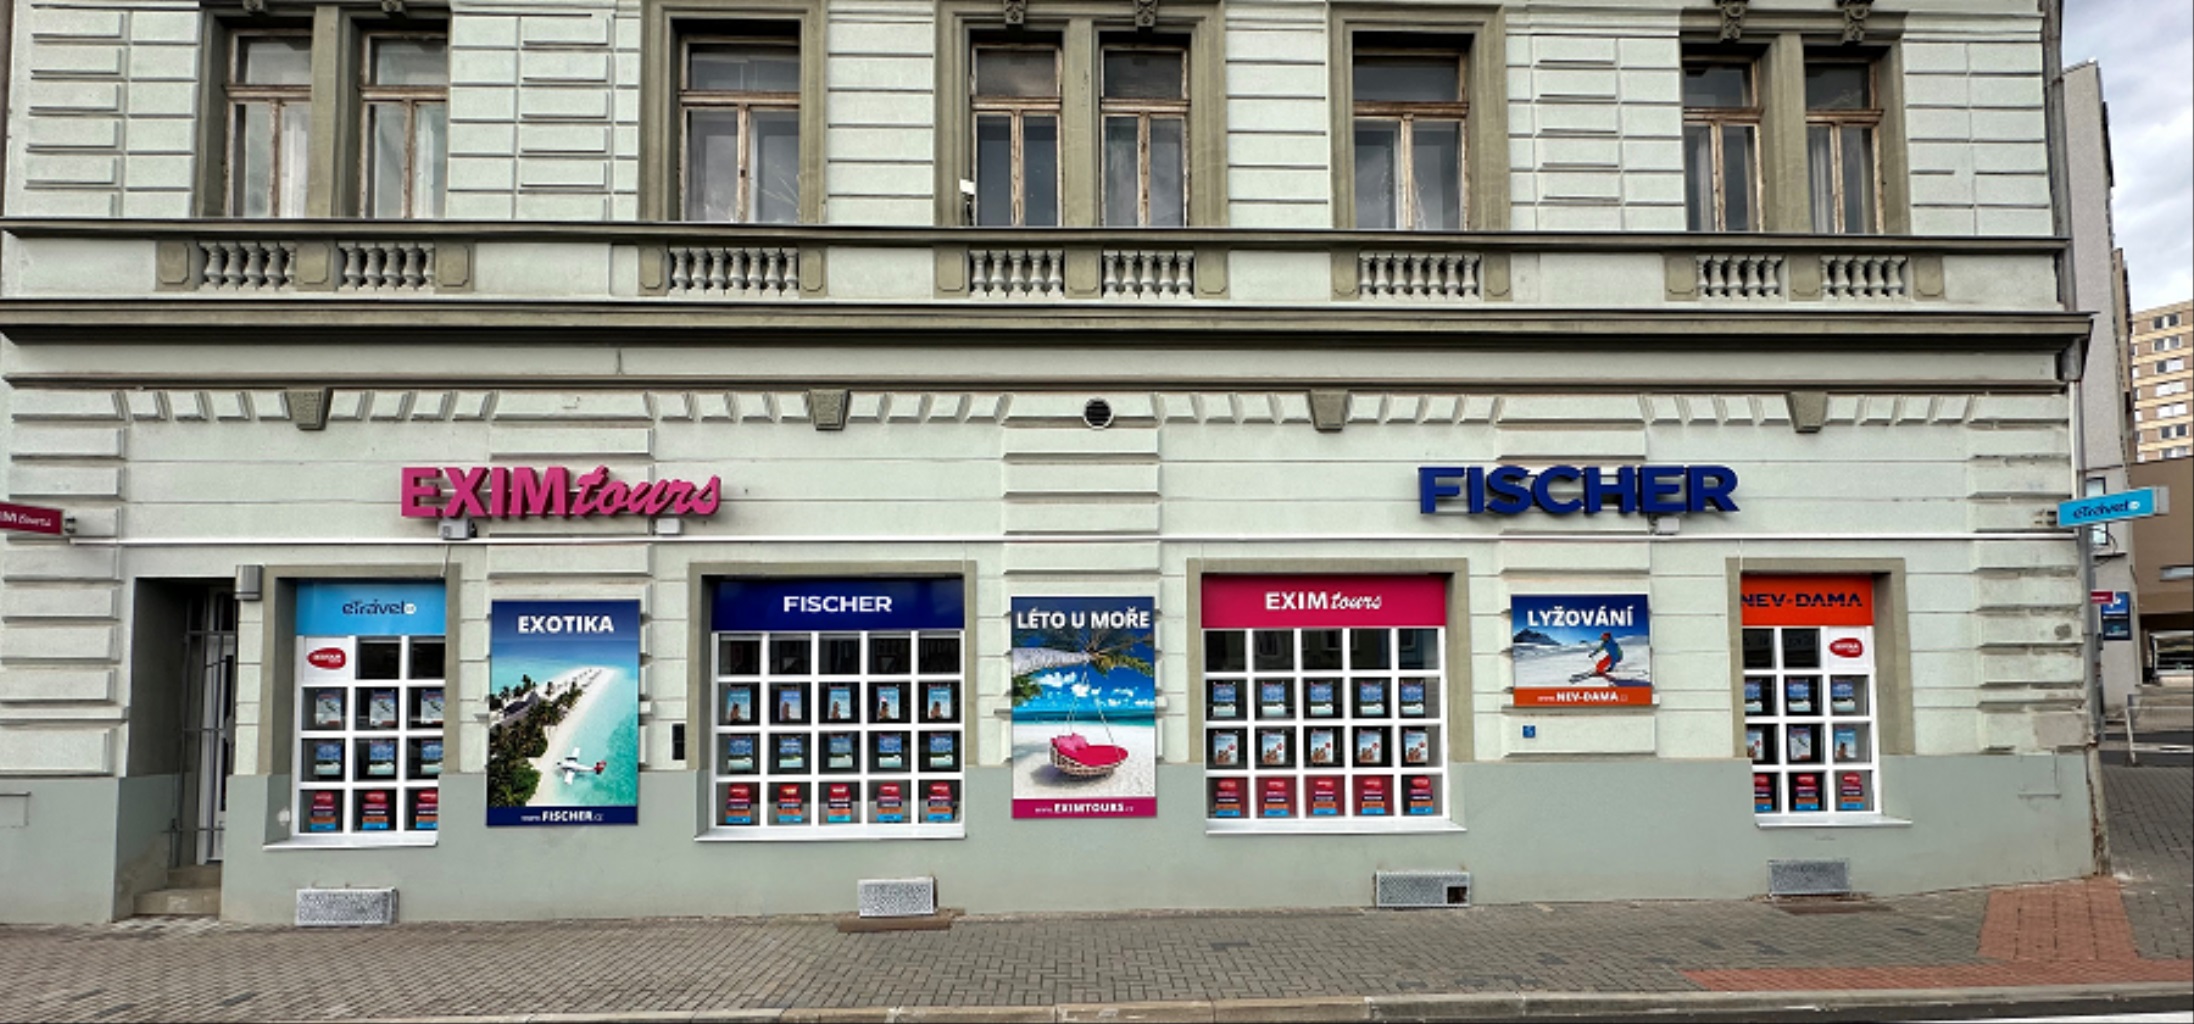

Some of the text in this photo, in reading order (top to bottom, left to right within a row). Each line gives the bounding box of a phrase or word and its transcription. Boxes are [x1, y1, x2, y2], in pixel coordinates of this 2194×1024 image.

[1418, 465, 1740, 515] FISCHER
[784, 596, 892, 612] FISCHER
[1741, 593, 1863, 608] NEV-DAMA
[517, 615, 614, 634] EXOTIKA
[1017, 606, 1150, 629] LÉTO U MOŘE
[1527, 605, 1634, 627] LYŽOVÁNÍ
